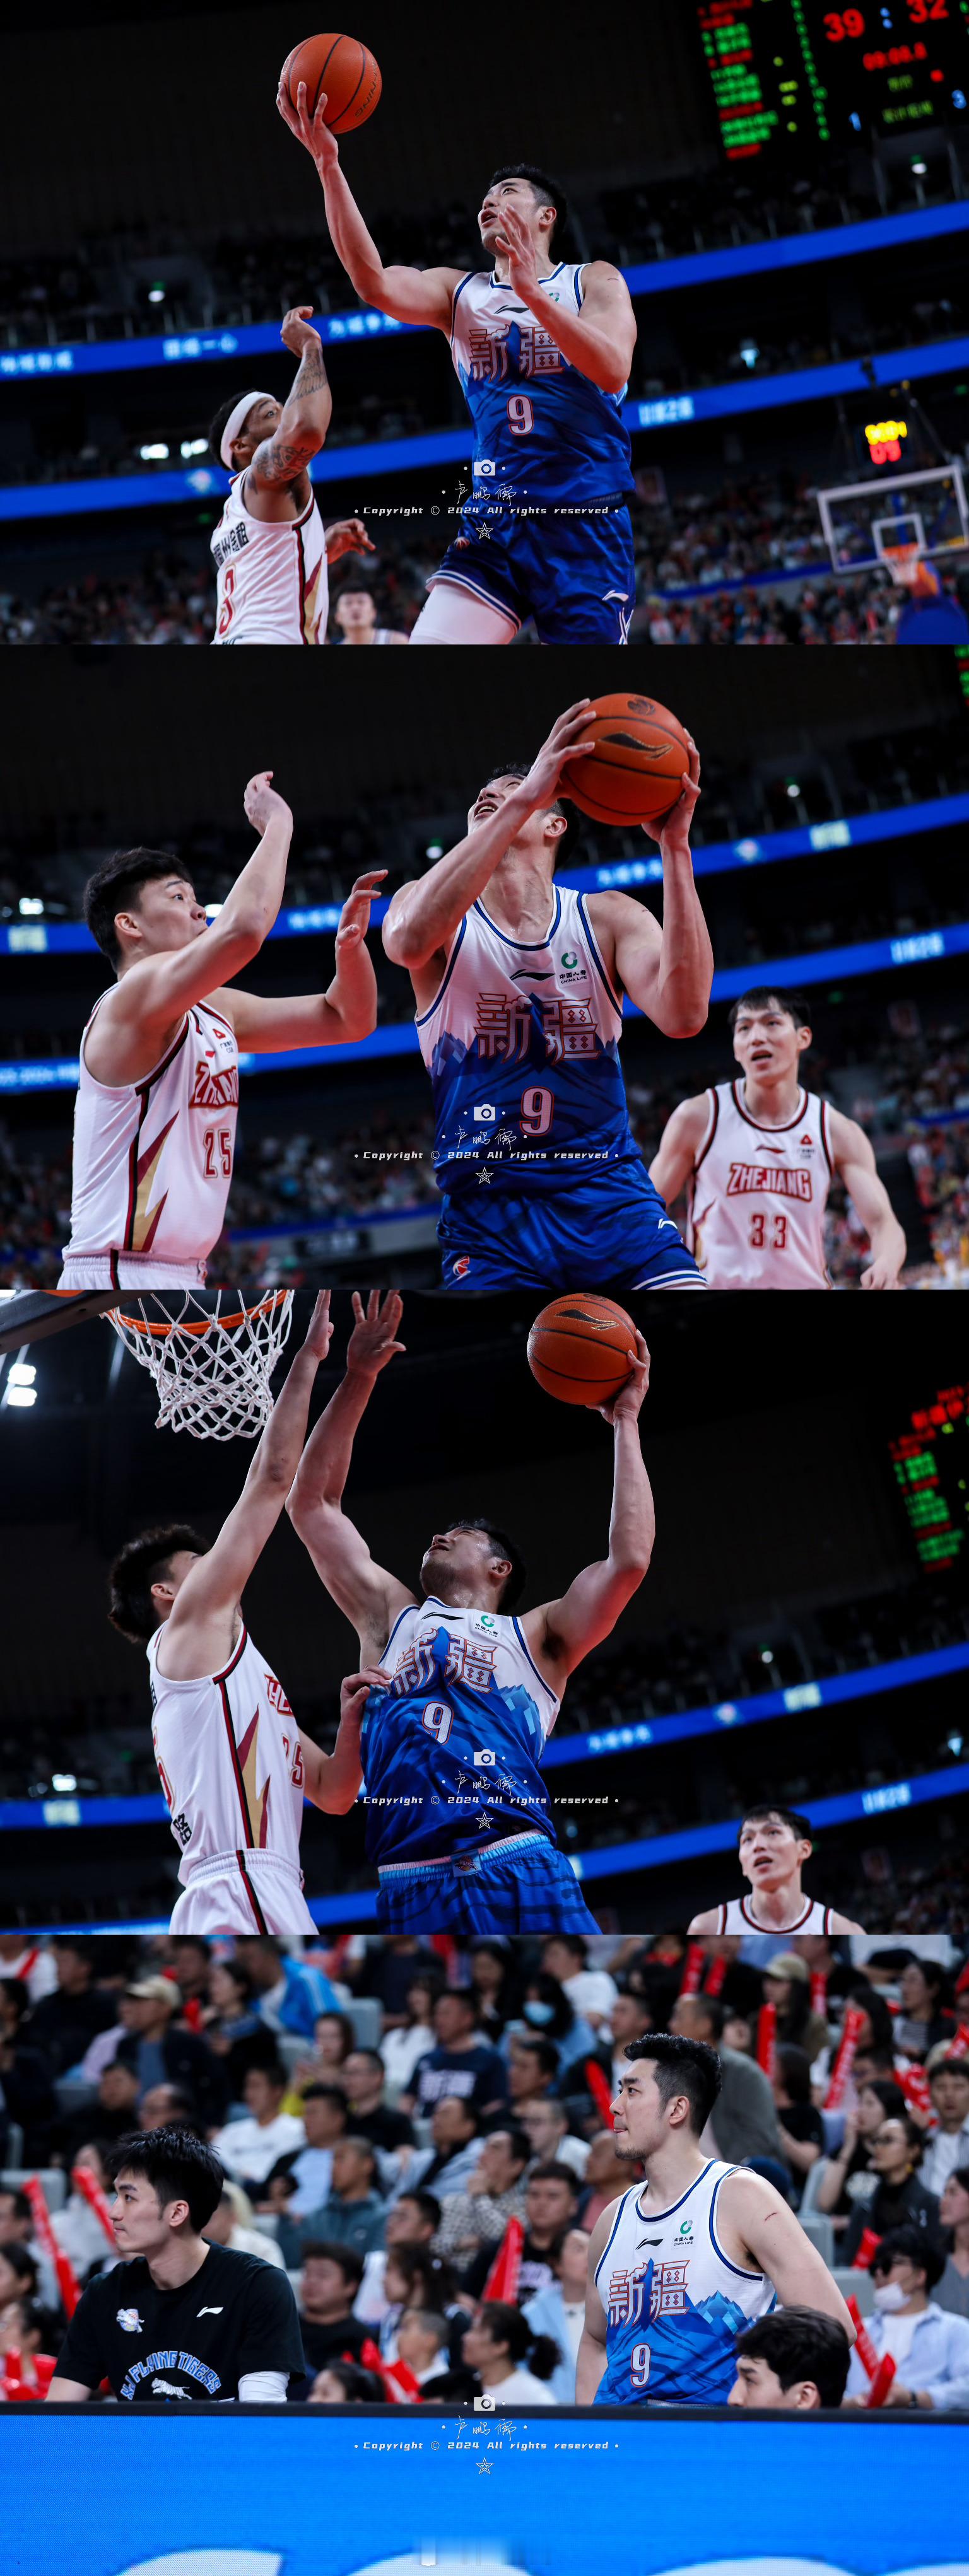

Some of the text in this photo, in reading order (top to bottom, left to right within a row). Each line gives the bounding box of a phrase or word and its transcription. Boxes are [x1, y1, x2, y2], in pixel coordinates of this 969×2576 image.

[823, 0, 949, 42] 39 32
[469, 324, 565, 383] 新疆
[507, 394, 534, 436] 9
[559, 969, 587, 980] 中国人寿
[474, 993, 602, 1066] 新疆
[520, 1085, 555, 1136] 9
[203, 1128, 232, 1179] 25
[727, 1162, 813, 1203] ZHEJIANG
[748, 1210, 789, 1251] 33
[393, 1628, 498, 1696] 新疆
[421, 1701, 454, 1746] 9
[608, 2259, 691, 2328] 新疆
[128, 2350, 178, 2384] FLYING
[177, 2352, 221, 2394] TIGERS
[631, 2343, 651, 2388] 9
